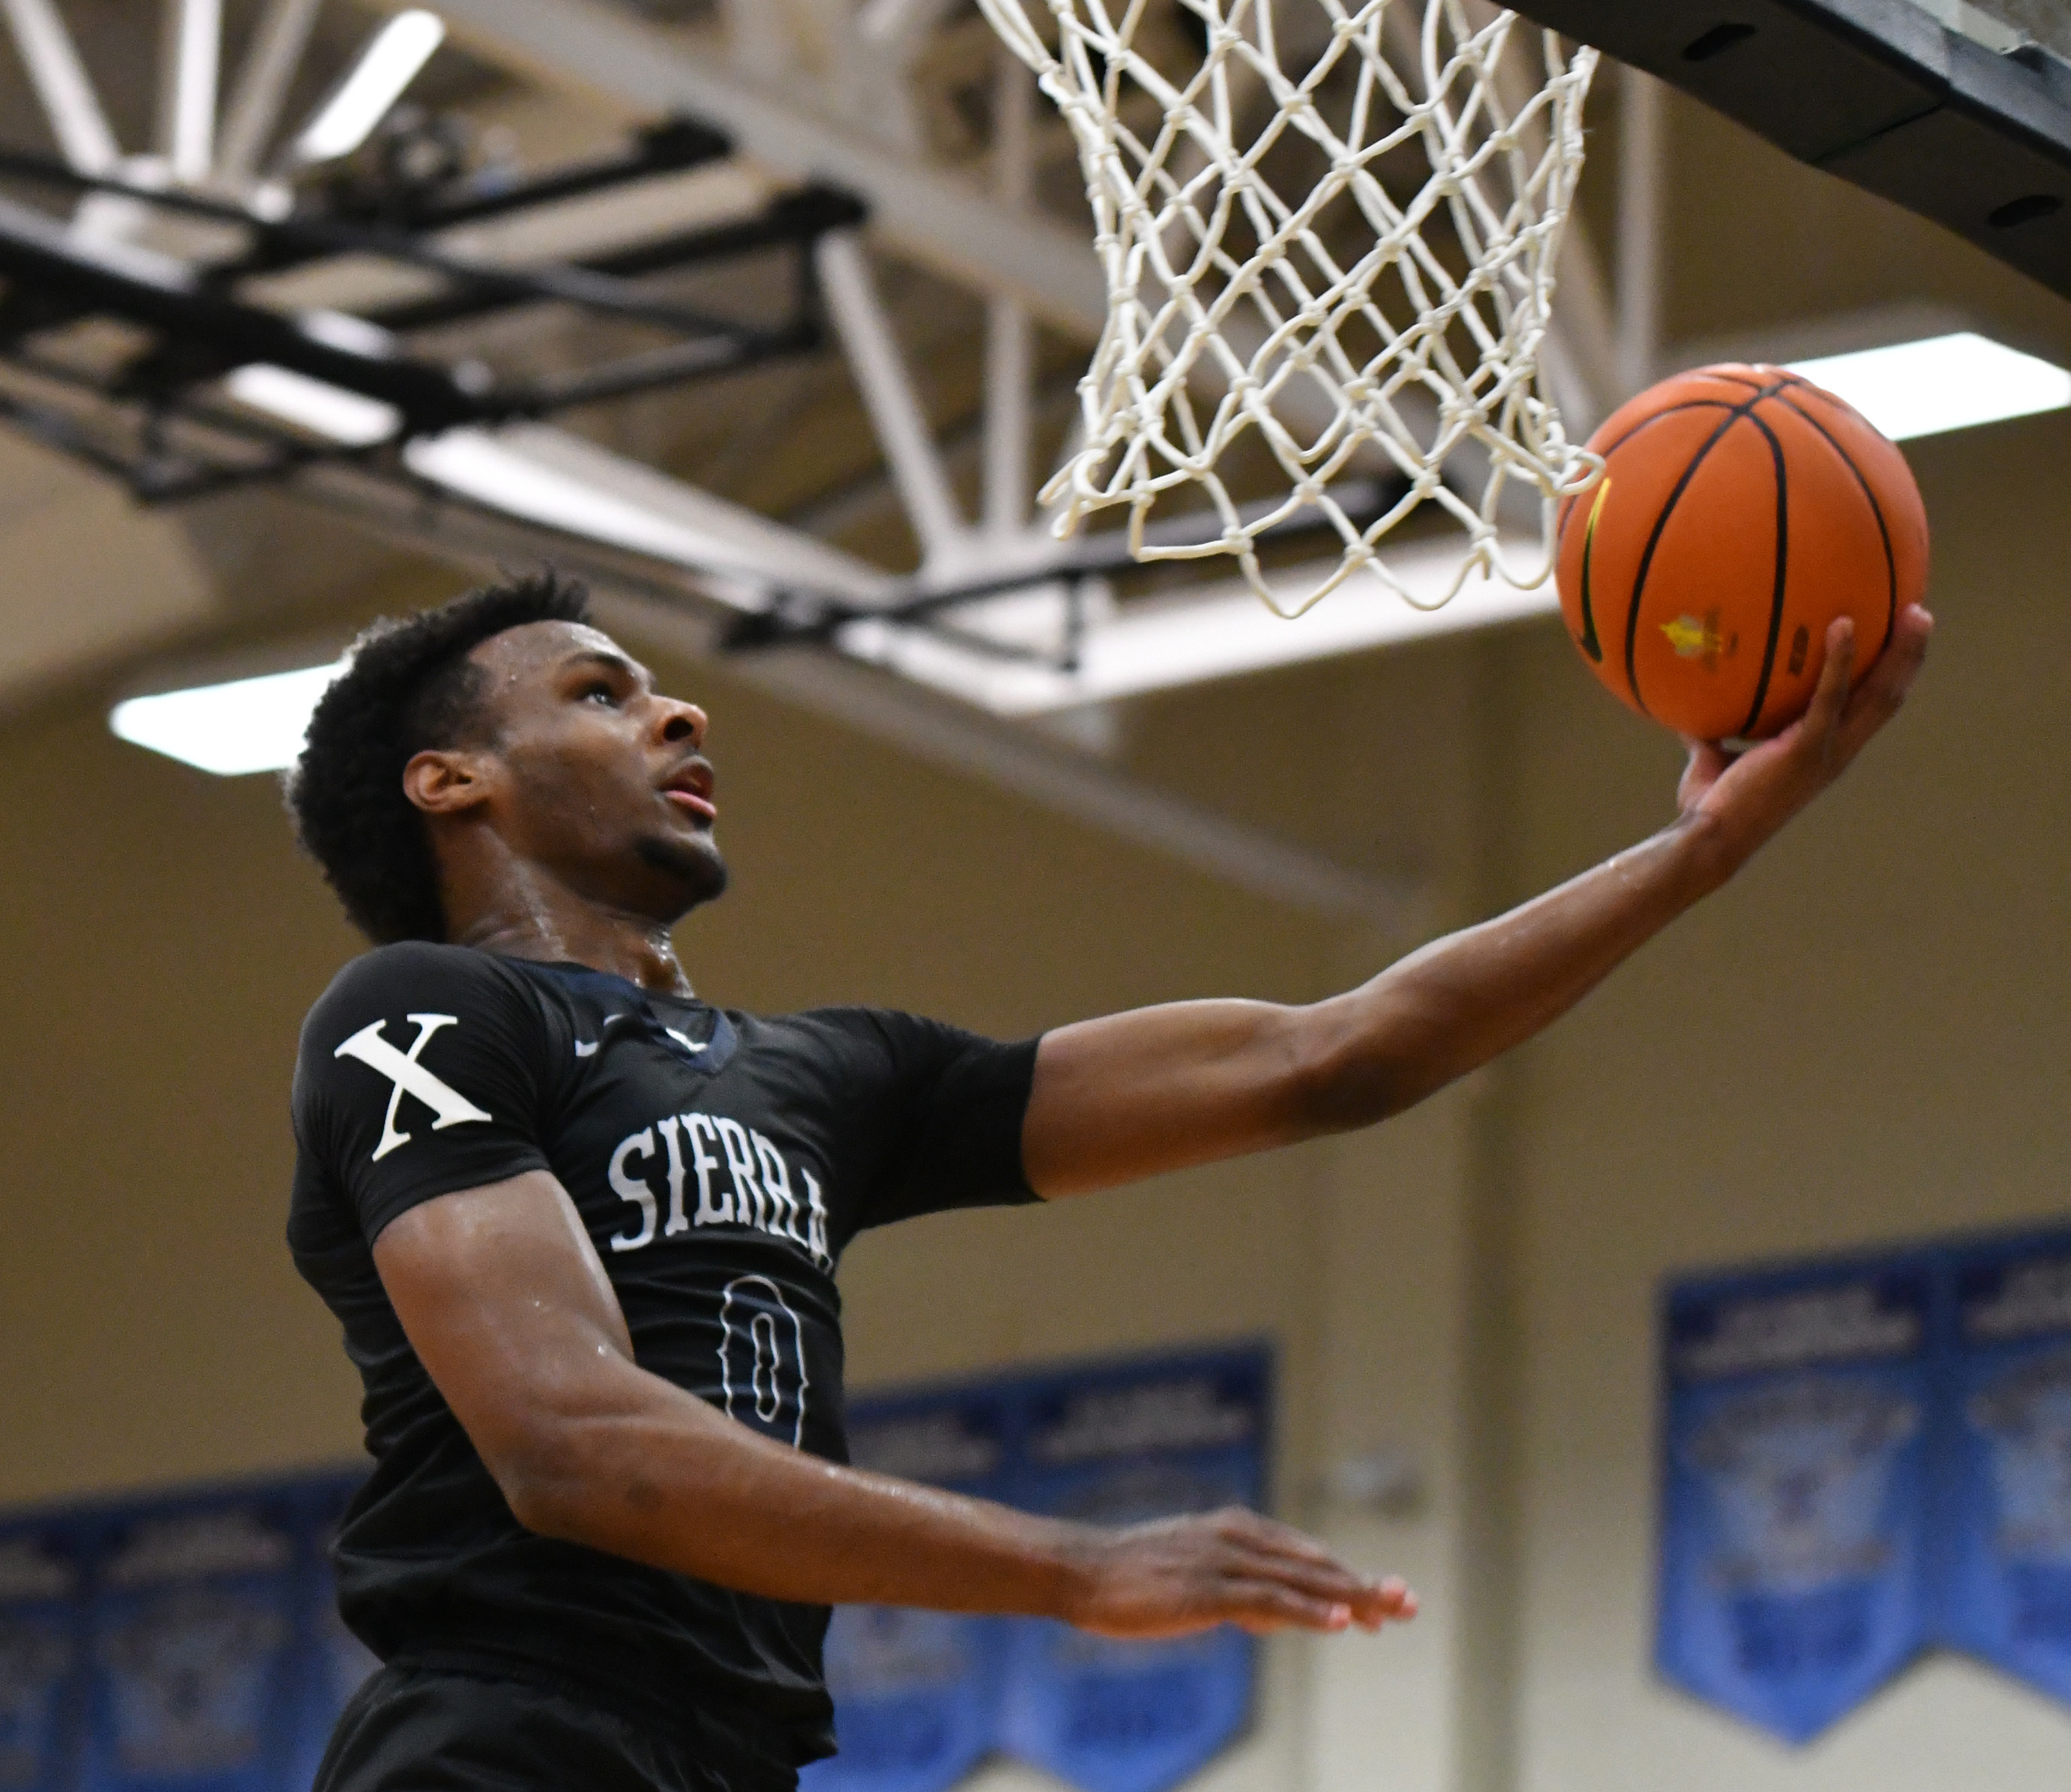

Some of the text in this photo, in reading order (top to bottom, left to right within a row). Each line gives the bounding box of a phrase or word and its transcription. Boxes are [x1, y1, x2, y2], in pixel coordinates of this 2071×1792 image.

[334, 1013, 493, 1162] X
[608, 1112, 833, 1275] SIERRA
[717, 1275, 809, 1451] 0
